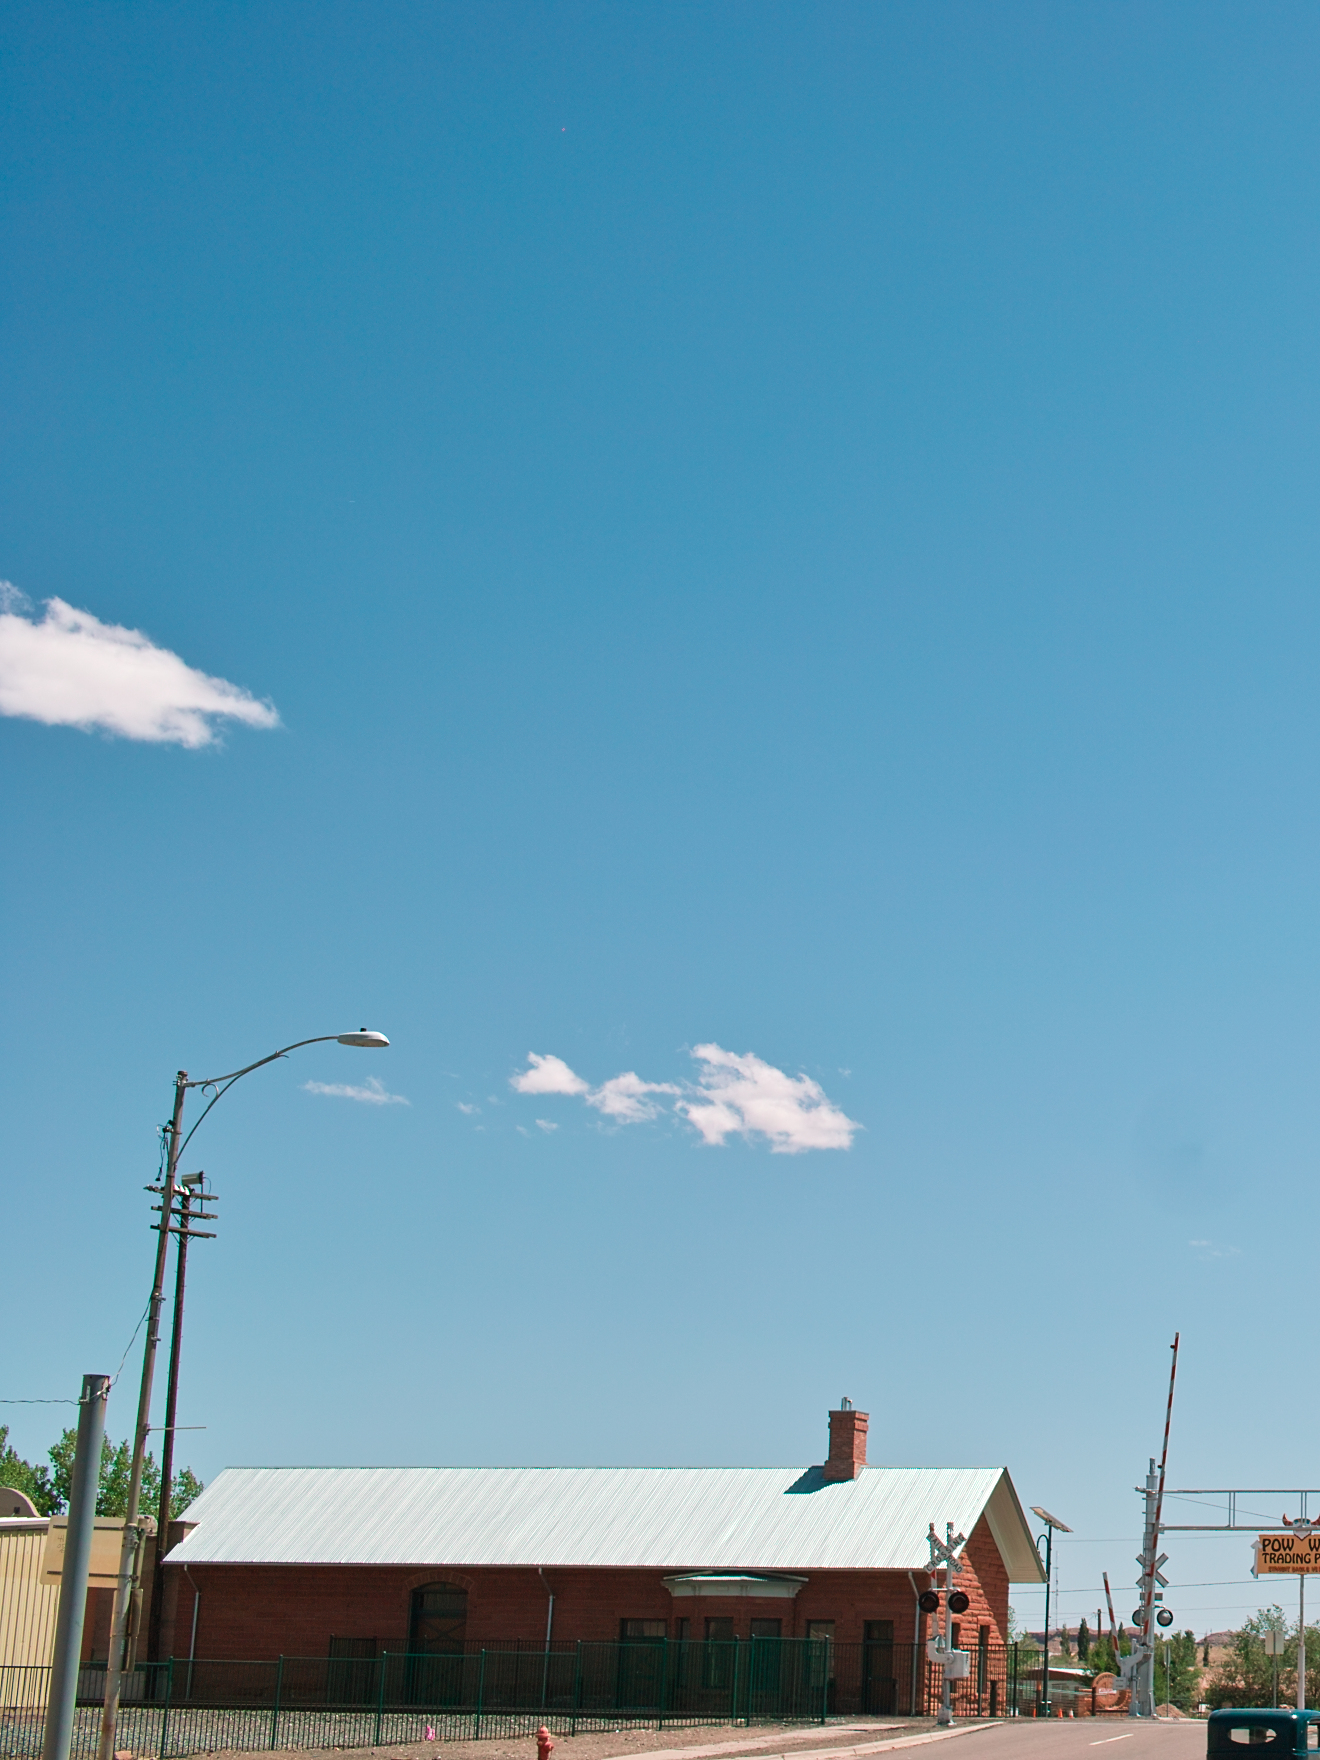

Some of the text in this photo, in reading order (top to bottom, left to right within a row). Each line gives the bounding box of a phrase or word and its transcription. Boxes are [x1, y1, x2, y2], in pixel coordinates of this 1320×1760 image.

[925, 1532, 965, 1572] CROSSING
[927, 1533, 963, 1573] RAIL ROAD
[1261, 1552, 1311, 1564] TRADING
[1262, 1538, 1295, 1552] POW
